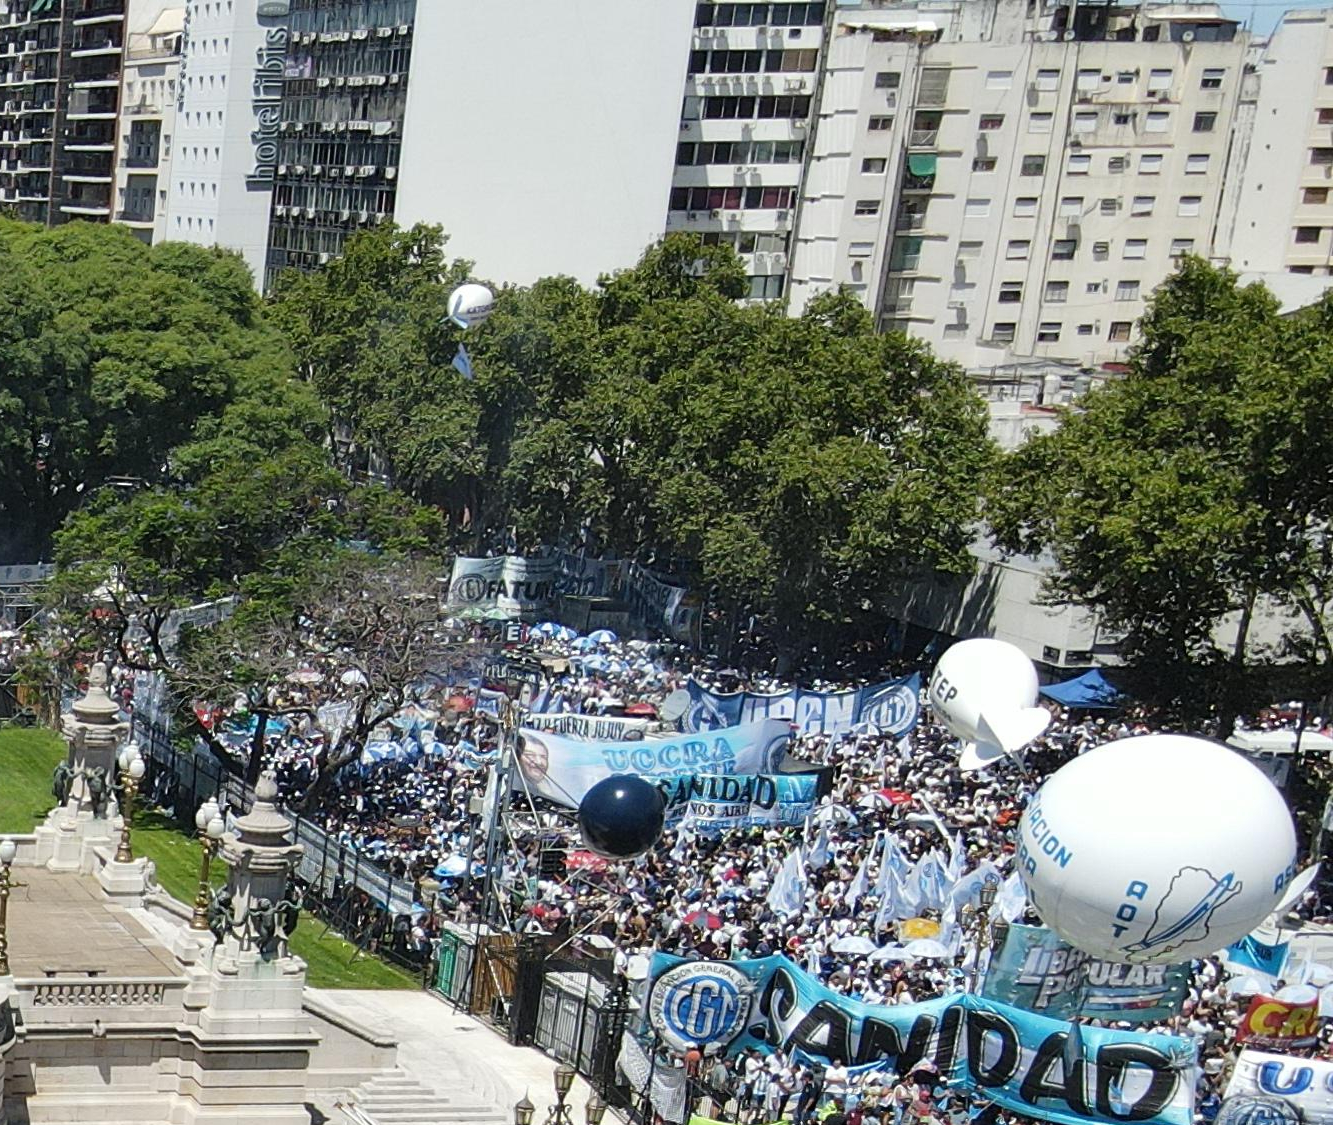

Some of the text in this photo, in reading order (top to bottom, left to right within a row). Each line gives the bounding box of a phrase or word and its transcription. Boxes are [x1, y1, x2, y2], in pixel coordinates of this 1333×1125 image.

[245, 27, 288, 190] hotel ibis
[748, 966, 1180, 1121] SANIDAD
